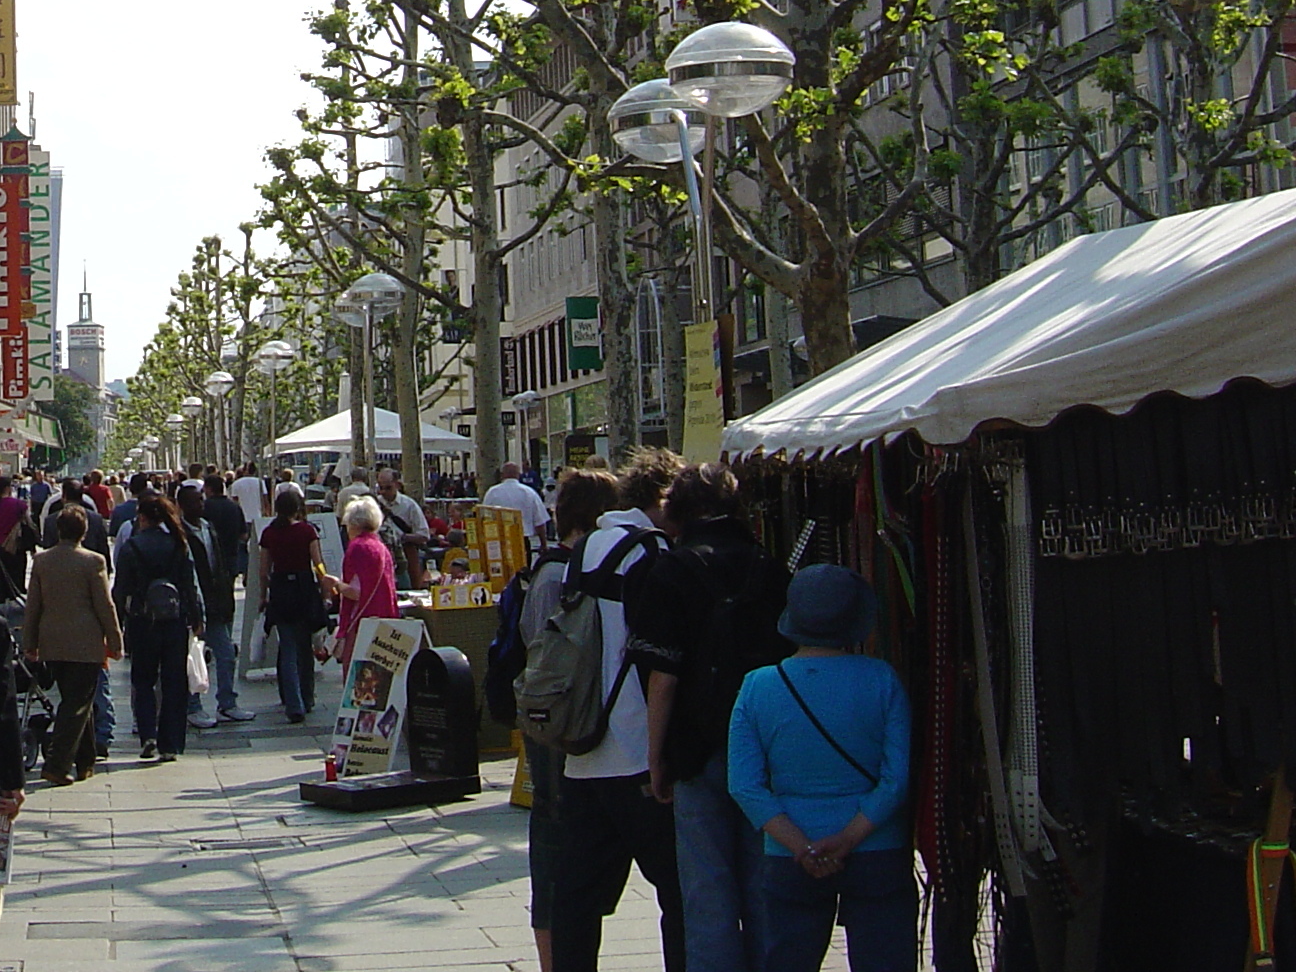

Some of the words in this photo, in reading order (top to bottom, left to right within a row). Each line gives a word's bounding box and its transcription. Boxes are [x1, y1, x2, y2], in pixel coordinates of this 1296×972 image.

[29, 162, 53, 391] SALAMANDER
[389, 629, 402, 641] Ist
[371, 636, 409, 661] Auschwitz
[351, 743, 389, 755] Holocaust
